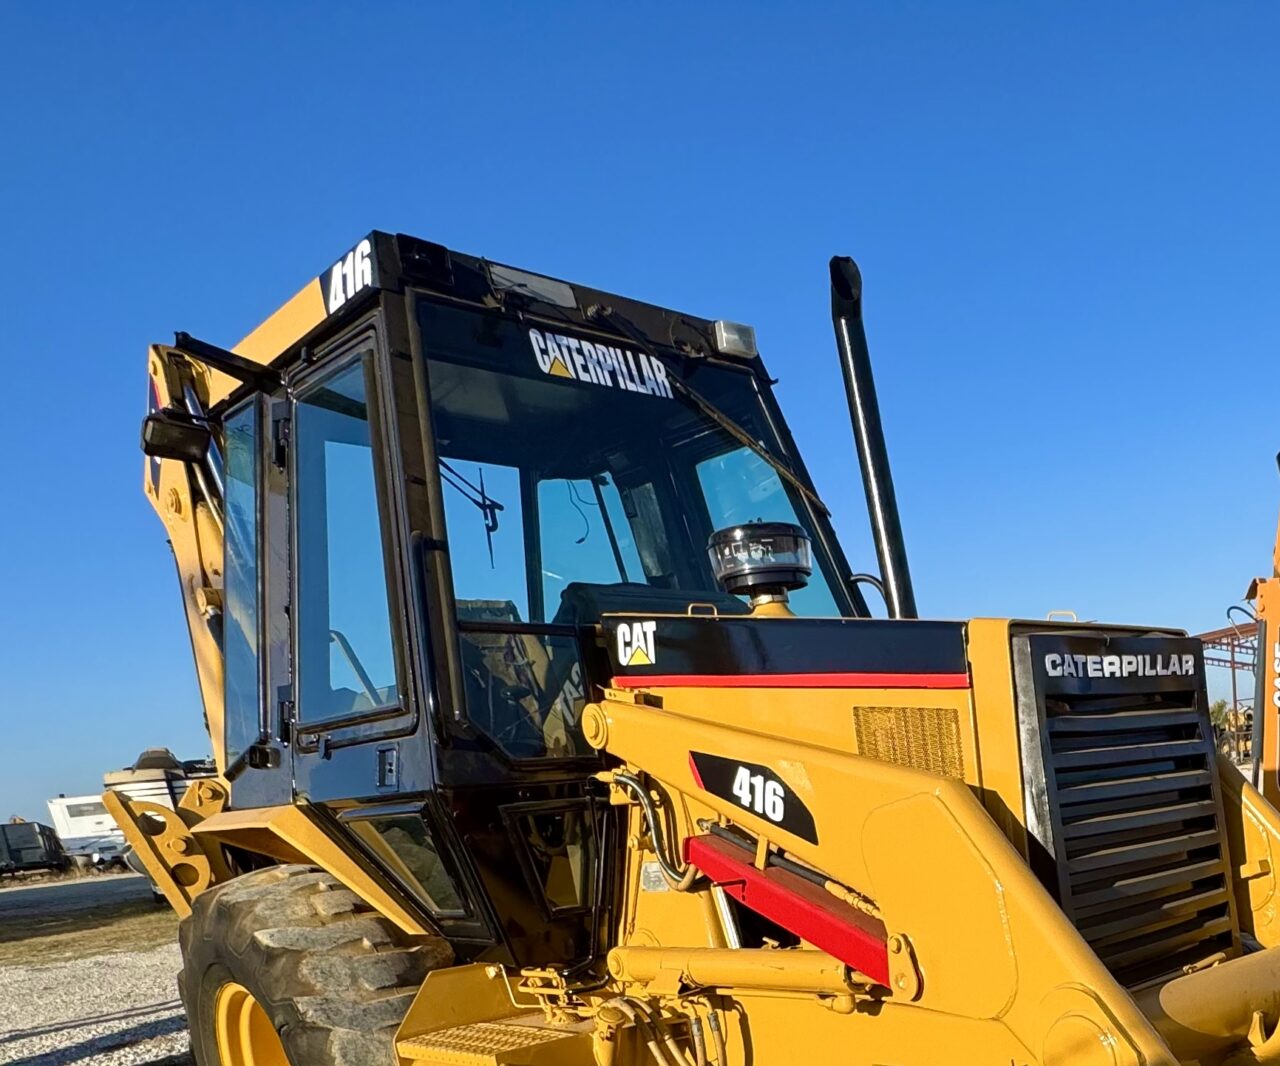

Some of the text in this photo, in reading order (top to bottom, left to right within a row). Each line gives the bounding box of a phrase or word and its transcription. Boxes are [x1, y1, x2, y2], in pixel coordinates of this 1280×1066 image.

[329, 239, 372, 315] 416
[529, 328, 674, 399] CATERPILLAR
[617, 620, 657, 666] CAT
[1045, 653, 1195, 677] CATERPILLAR
[733, 766, 784, 822] 416
